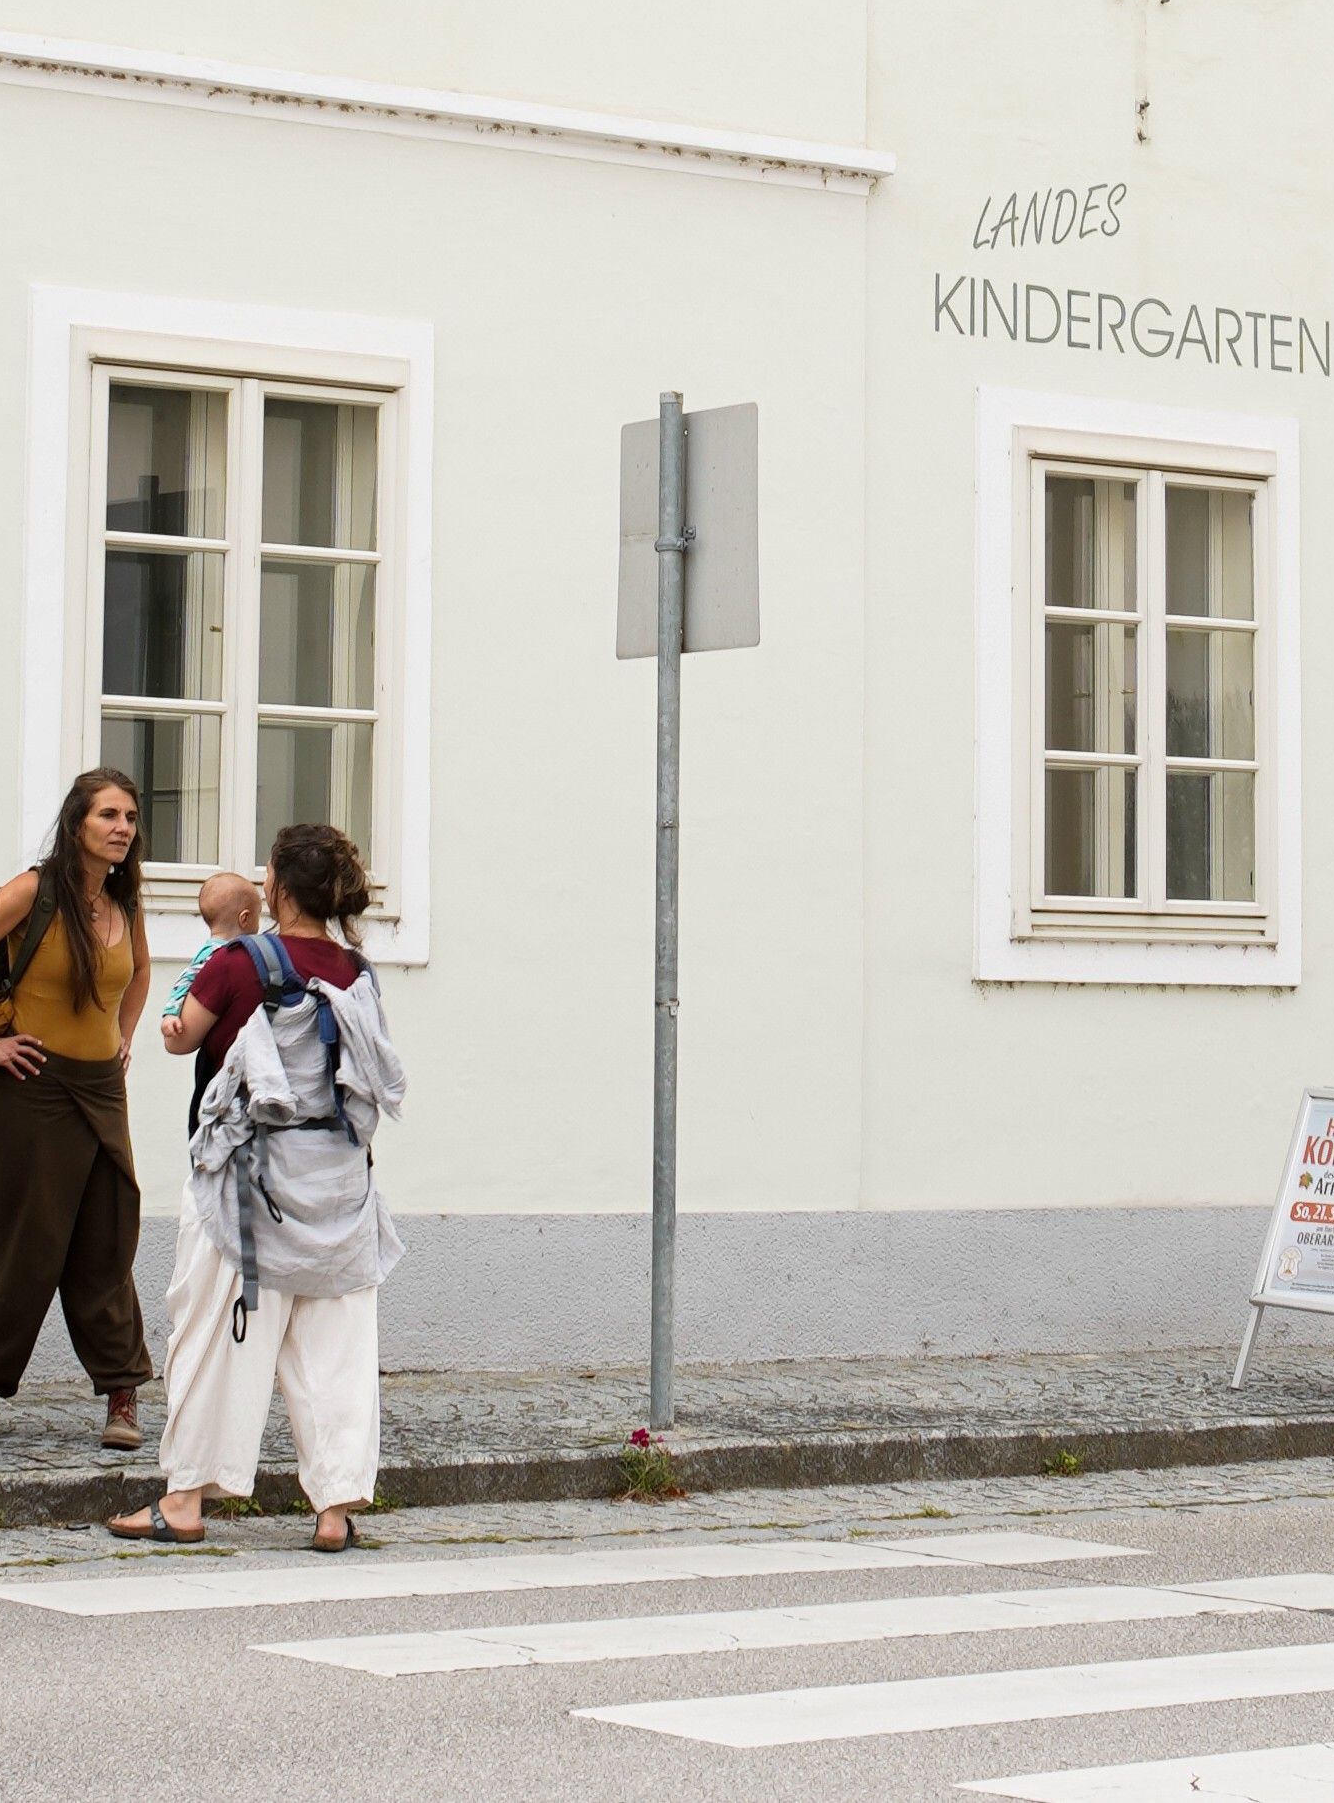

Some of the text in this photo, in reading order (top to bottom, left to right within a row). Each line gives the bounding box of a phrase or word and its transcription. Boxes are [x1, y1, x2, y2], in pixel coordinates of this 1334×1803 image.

[972, 182, 1128, 250] LANDES
[934, 272, 1331, 377] KINDERGARTEN
[1294, 1203, 1311, 1220] So,
